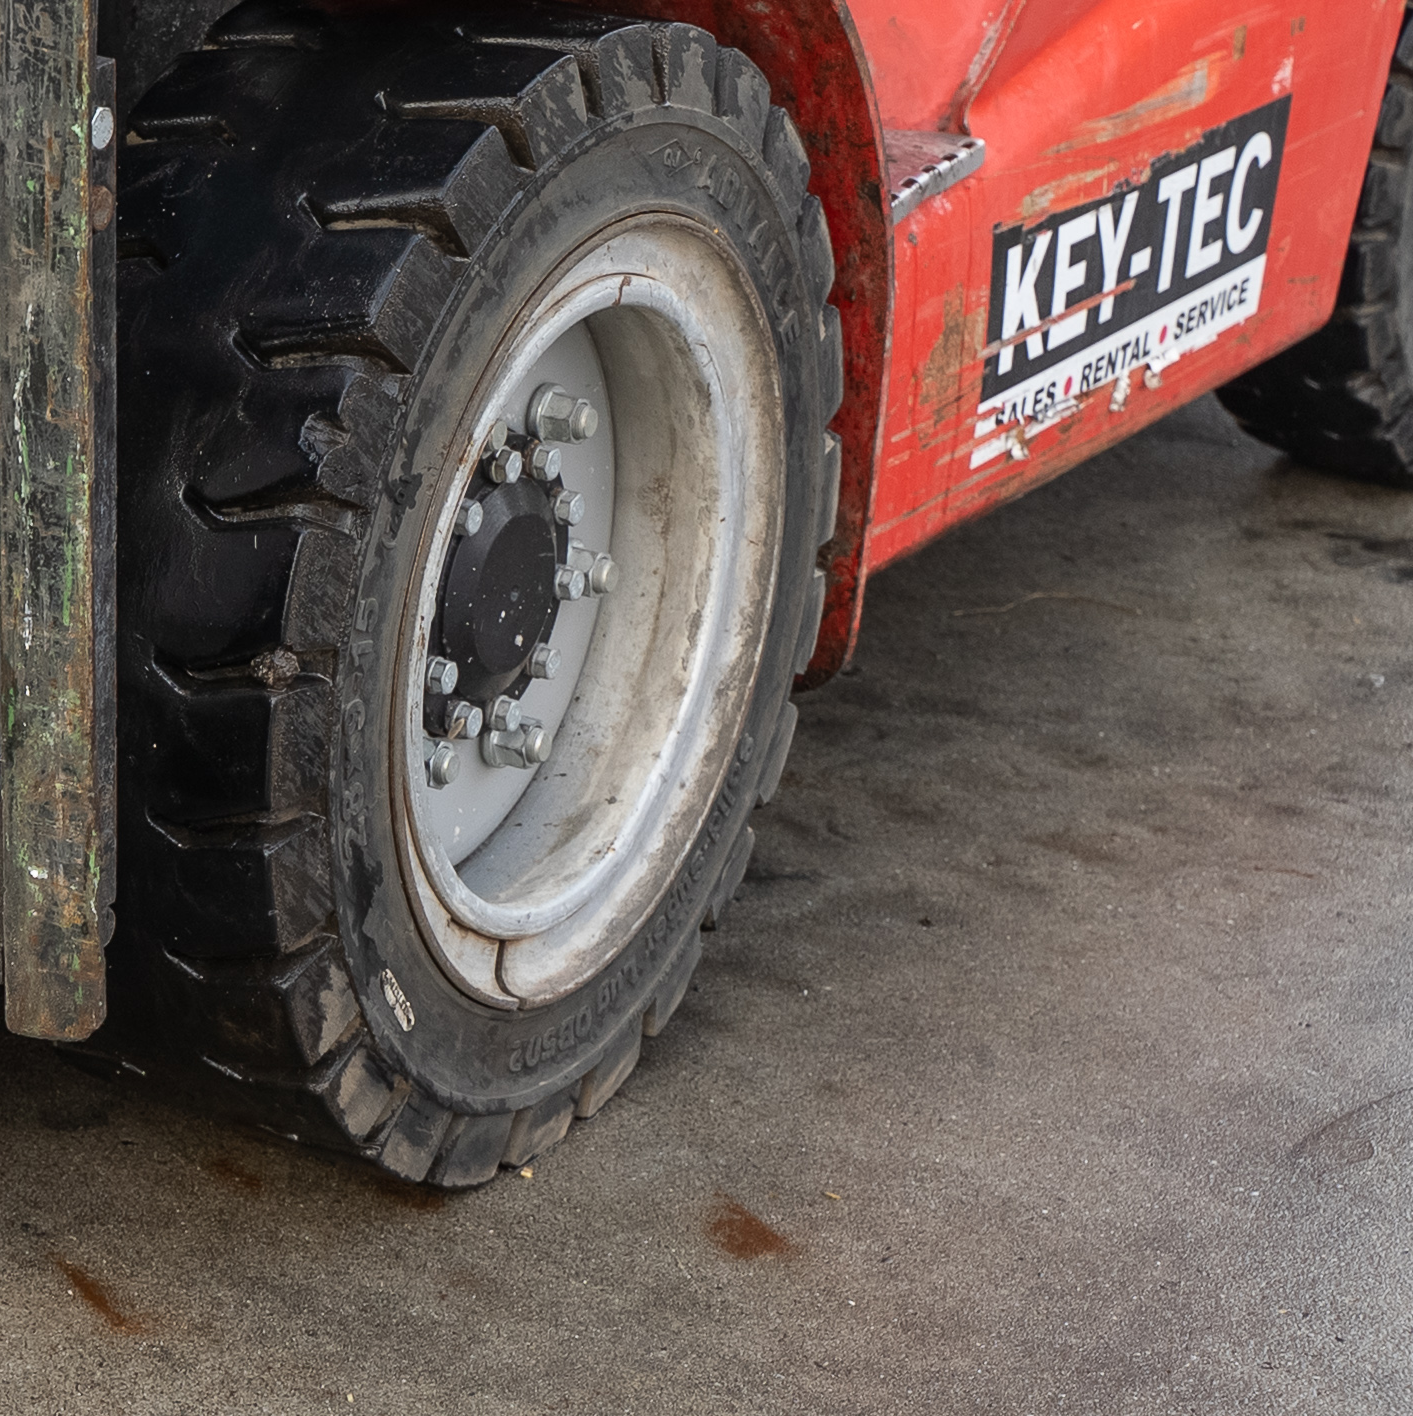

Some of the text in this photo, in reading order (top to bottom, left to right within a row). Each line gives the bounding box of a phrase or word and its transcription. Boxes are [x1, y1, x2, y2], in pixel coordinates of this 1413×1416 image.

[997, 131, 1272, 376] KEY-TEC
[1081, 331, 1152, 392] RENTAL
[1174, 277, 1251, 340] SERVICE
